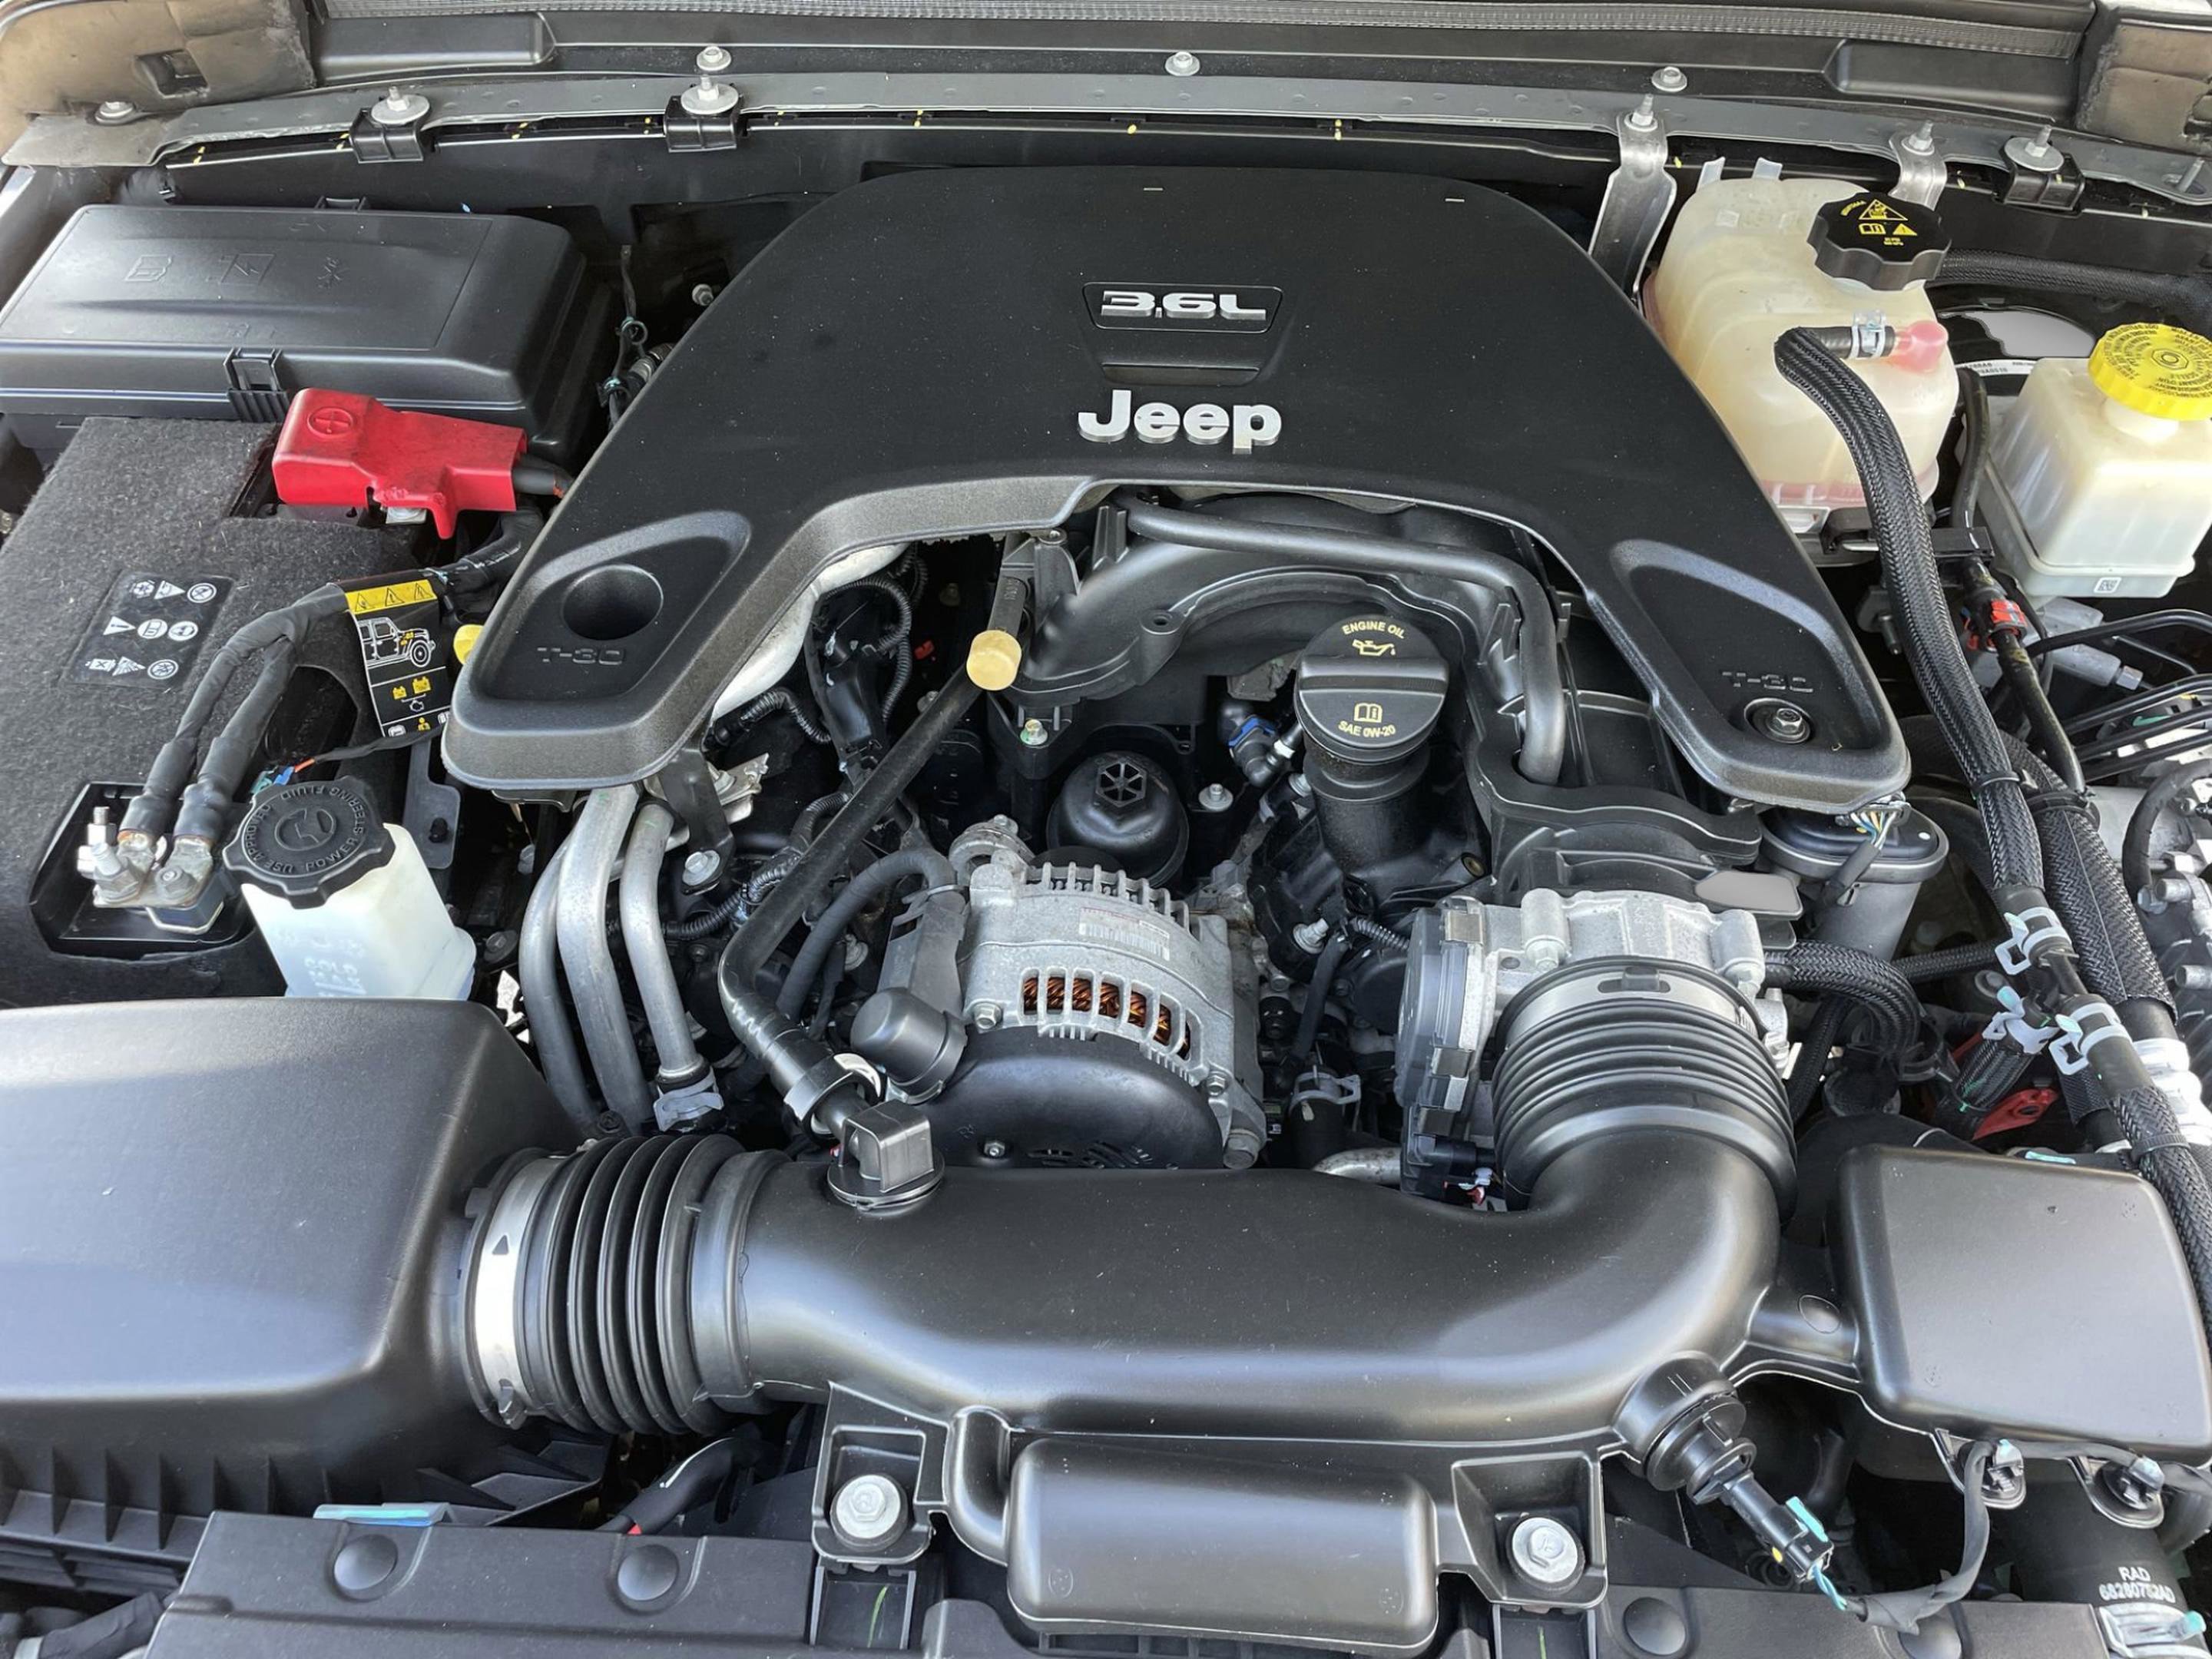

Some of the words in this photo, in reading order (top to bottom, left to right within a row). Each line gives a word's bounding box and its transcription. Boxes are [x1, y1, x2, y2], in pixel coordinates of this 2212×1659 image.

[1101, 290, 1267, 320] 3.6L
[1078, 389, 1282, 455] Jeep
[1342, 621, 1386, 635] ENGINE
[1387, 624, 1406, 639] OIL
[537, 647, 623, 666] T-30
[1338, 720, 1362, 737] SAE
[1363, 724, 1396, 737] 0W-20
[280, 784, 326, 800] FLUID
[329, 786, 366, 836] STEERING
[246, 804, 272, 861] APPROVED
[305, 837, 359, 872] POWER
[267, 859, 295, 873] USE
[2118, 1566, 2151, 1581] RAD
